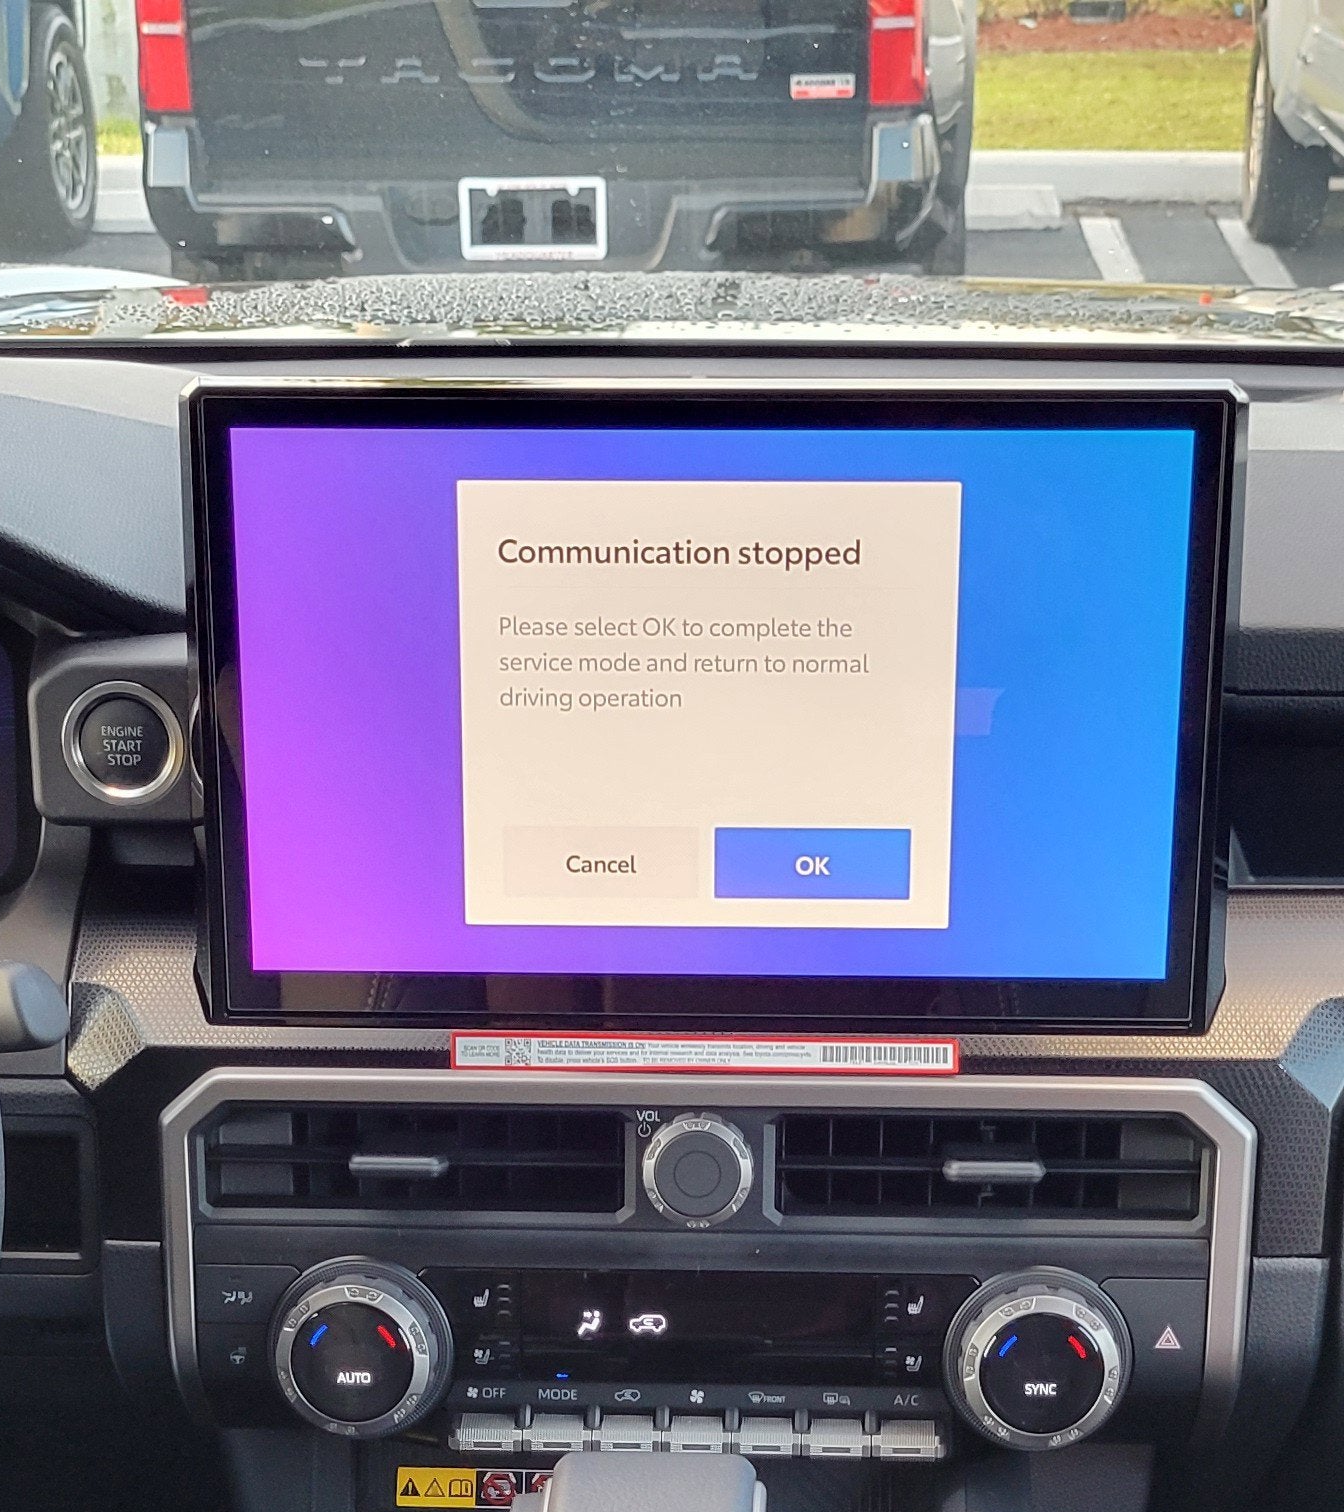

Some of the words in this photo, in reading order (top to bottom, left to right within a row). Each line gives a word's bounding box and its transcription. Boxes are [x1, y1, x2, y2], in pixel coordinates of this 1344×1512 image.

[498, 539, 731, 565] Communication
[738, 539, 861, 571] stopped
[499, 617, 568, 637] Please
[574, 617, 638, 637] select
[642, 618, 676, 637] OK
[682, 620, 704, 638] to
[709, 618, 812, 641] complete
[817, 618, 853, 638] the
[499, 653, 573, 672] service
[578, 653, 641, 672] mode
[646, 653, 687, 672] and
[693, 655, 757, 673] return
[764, 655, 786, 673] to
[792, 653, 870, 674] normal
[499, 687, 573, 711] driving
[578, 688, 682, 711] operation
[101, 725, 143, 737] ENGINE
[103, 739, 142, 751] START
[107, 754, 141, 766] STOP
[565, 853, 637, 876] Cancel
[795, 856, 831, 877] OK
[636, 1110, 661, 1123] VOL
[337, 1372, 371, 1384] AUTO
[482, 1387, 507, 1398] OFF
[538, 1388, 578, 1400] MODE
[1024, 1384, 1056, 1396] SYNC
[764, 1395, 786, 1403] FRONT
[894, 1394, 919, 1406] A/C
